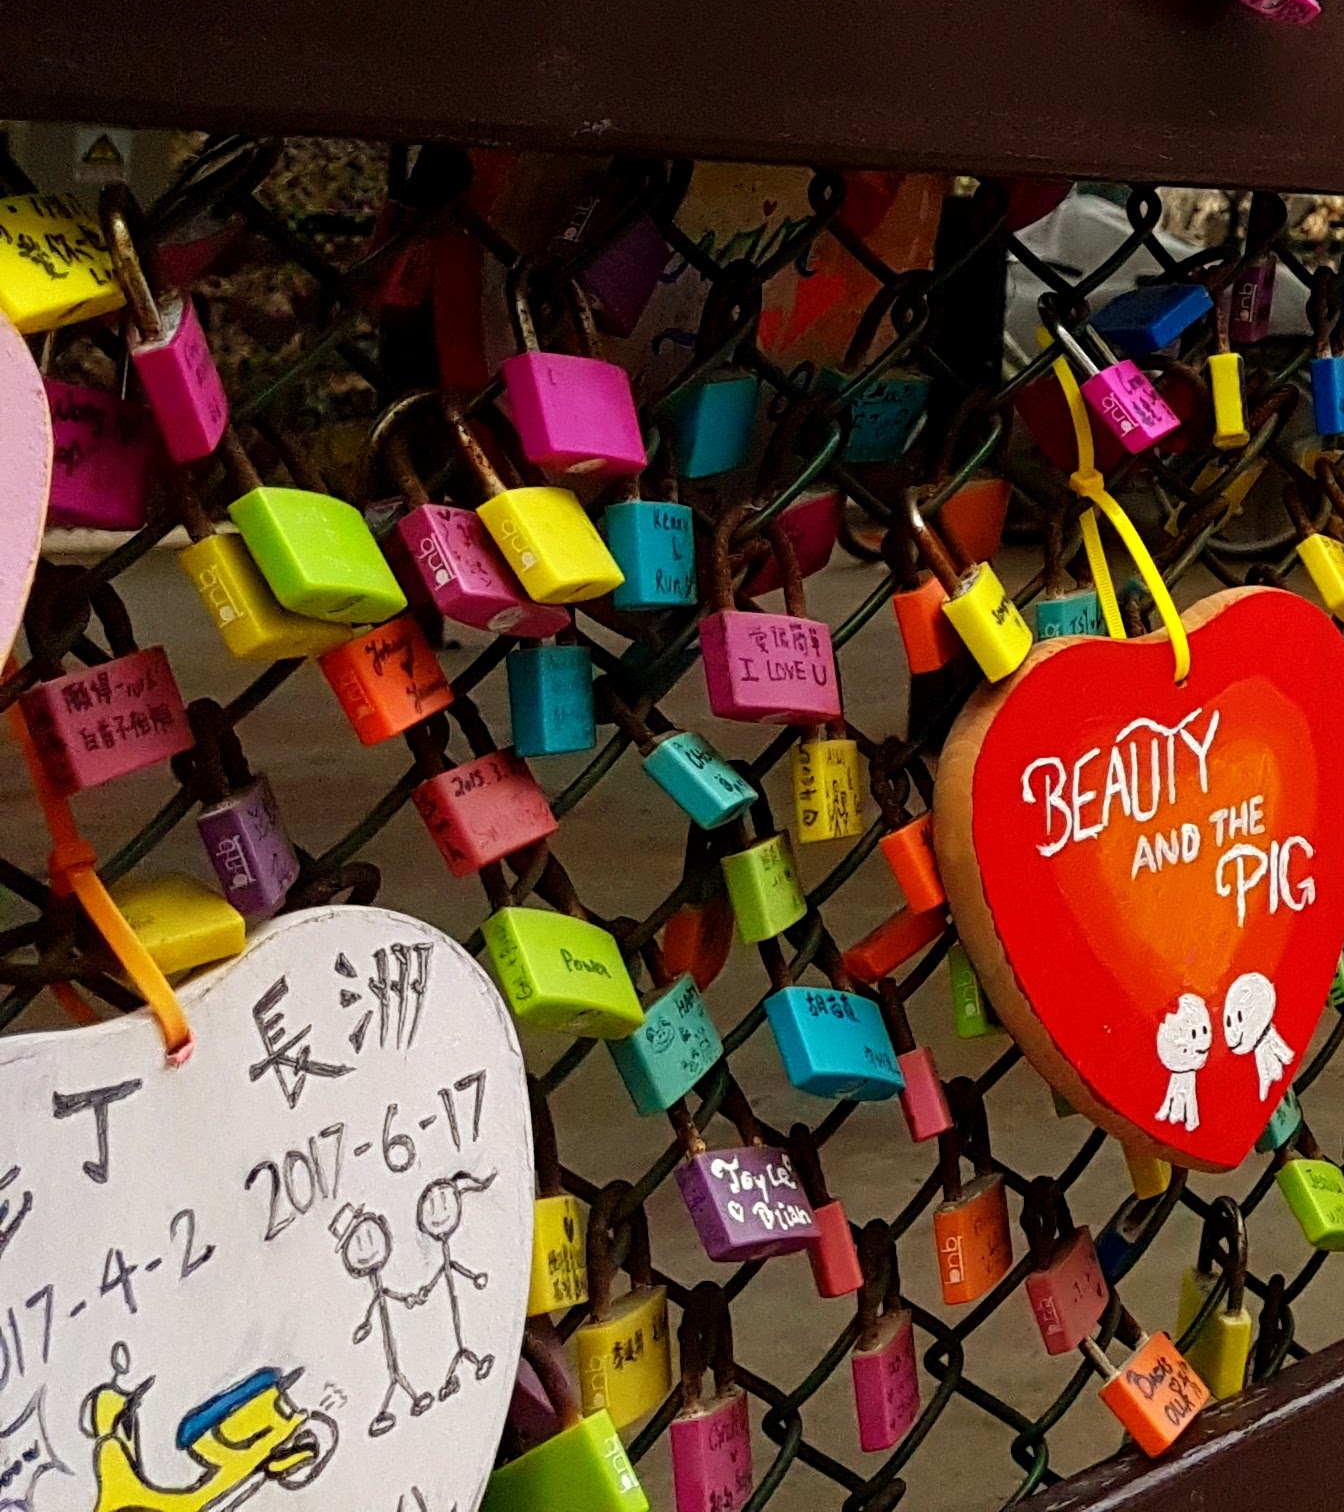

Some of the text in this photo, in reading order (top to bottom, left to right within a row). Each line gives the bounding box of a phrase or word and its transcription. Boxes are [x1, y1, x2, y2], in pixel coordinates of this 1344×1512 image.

[1102, 392, 1138, 438] bnb
[417, 532, 456, 591] bnb
[501, 520, 538, 571] bnb
[200, 565, 244, 629] bnb
[738, 658, 828, 686] I LOVE U
[1022, 706, 1220, 857] BEAUTY
[216, 835, 257, 889] bnb
[1132, 795, 1265, 881] AND THE
[1216, 835, 1316, 928] PIG
[245, 1069, 488, 1241] 2017-6-17
[941, 1236, 965, 1284] bnb
